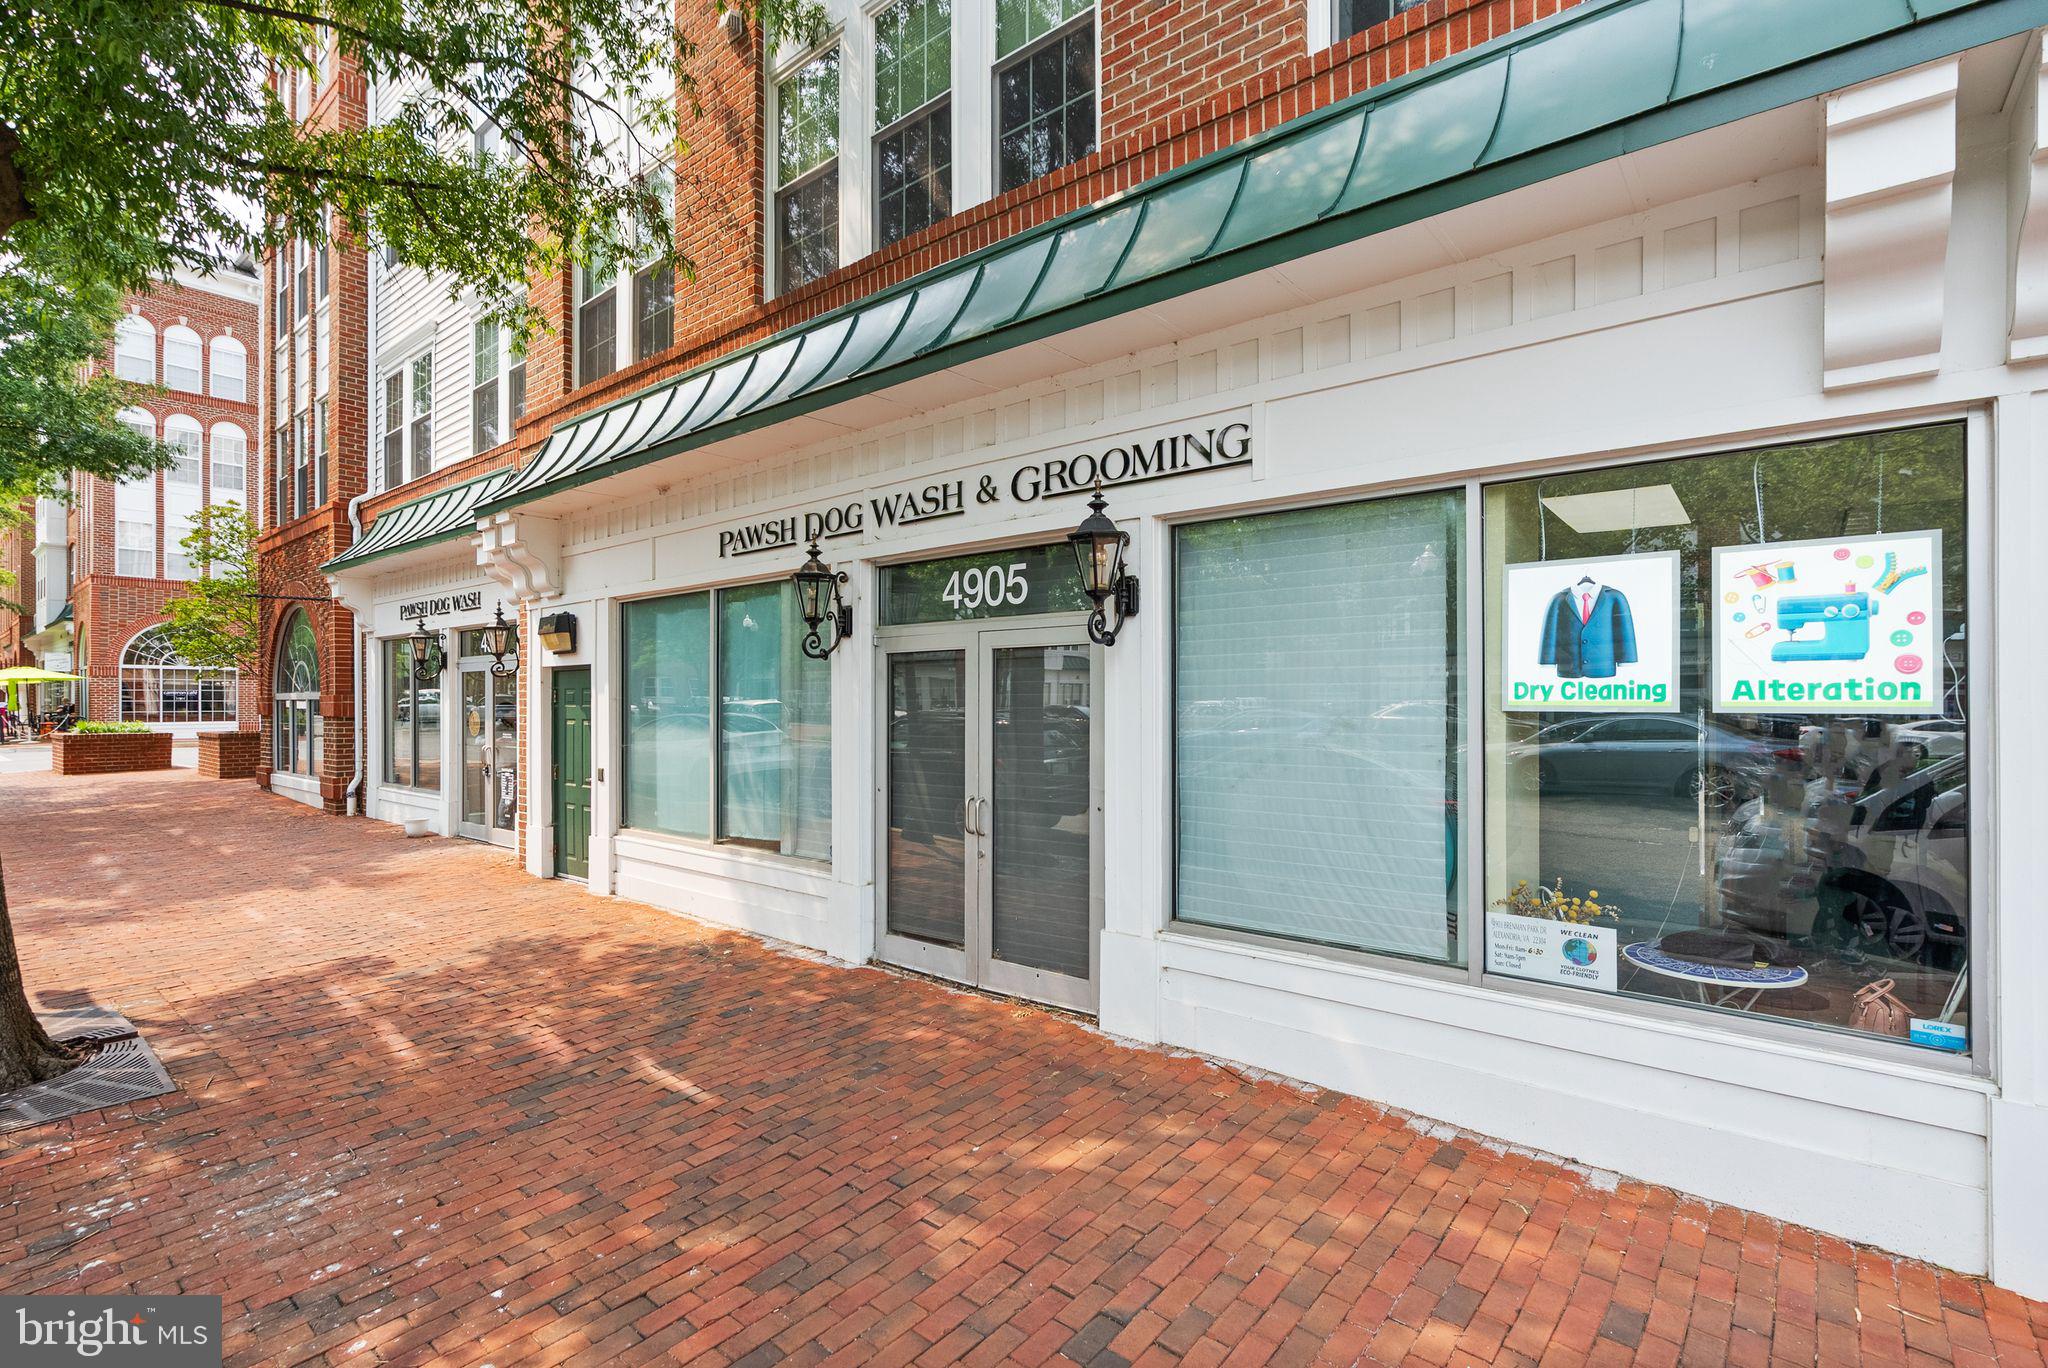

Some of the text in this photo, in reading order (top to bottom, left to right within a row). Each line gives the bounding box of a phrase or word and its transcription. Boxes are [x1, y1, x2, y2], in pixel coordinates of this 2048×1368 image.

[719, 423, 1253, 558] PAWSH DOG WASH & GROOMING
[941, 563, 1028, 610] 4905
[400, 591, 482, 621] PAWSH DOG WASH
[1513, 679, 1667, 702] Dry Cleaning
[1731, 677, 1922, 701] Alteration
[1527, 924, 1540, 934] PARK
[1574, 931, 1599, 940] CLEAN
[1505, 960, 1522, 970] Closed
[1576, 966, 1599, 975] CLOTHES
[1560, 969, 1599, 980] ECO-FRIENDLY
[1922, 1023, 1952, 1033] LOREX
